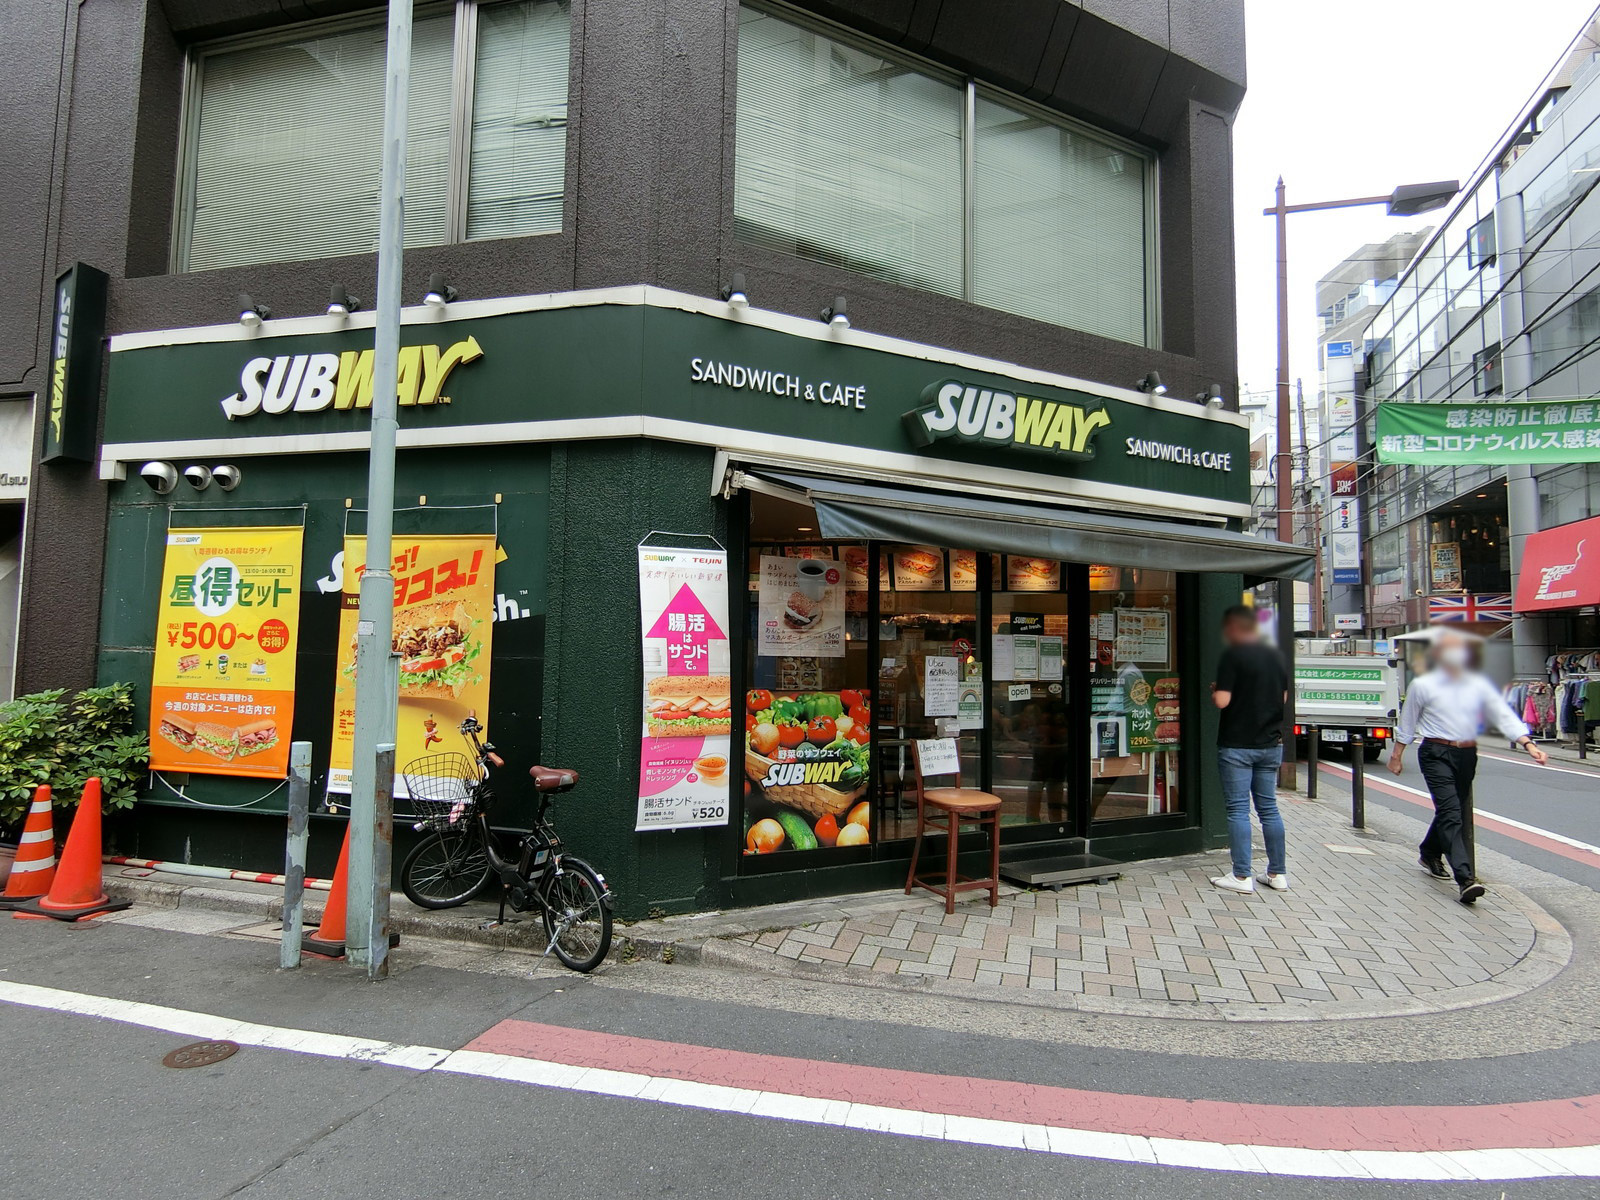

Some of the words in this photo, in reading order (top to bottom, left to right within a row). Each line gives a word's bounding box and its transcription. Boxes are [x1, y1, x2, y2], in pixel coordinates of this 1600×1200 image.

[51, 288, 71, 443] SUBWAY
[221, 335, 484, 421] SUBWAY
[691, 358, 800, 398] SANDWICH
[804, 384, 815, 401] &
[819, 382, 866, 409] CAFÉ
[922, 383, 1111, 453] SUBWAY
[1126, 438, 1191, 465] SANDWICH
[1193, 453, 1201, 466] &
[1202, 453, 1231, 472] CAFÉ
[644, 554, 675, 562] SUBWAY
[692, 557, 722, 565] TEIJIN
[170, 566, 292, 607] 昼得セット
[668, 613, 705, 632] 腸活
[1013, 617, 1039, 625] SUBWAY
[683, 633, 692, 643] は
[668, 644, 708, 659] サンド
[185, 693, 254, 703] お店ごとに毎週替わる
[1011, 688, 1029, 698] open
[165, 702, 276, 715] 今週の対象メニューは店内で!
[1132, 720, 1152, 731] ドッグ
[778, 749, 841, 760] 野菜のサブウェイ
[761, 760, 853, 787] SUBWAY
[644, 796, 692, 809] 腸活サンド
[692, 806, 724, 819] ¥520
